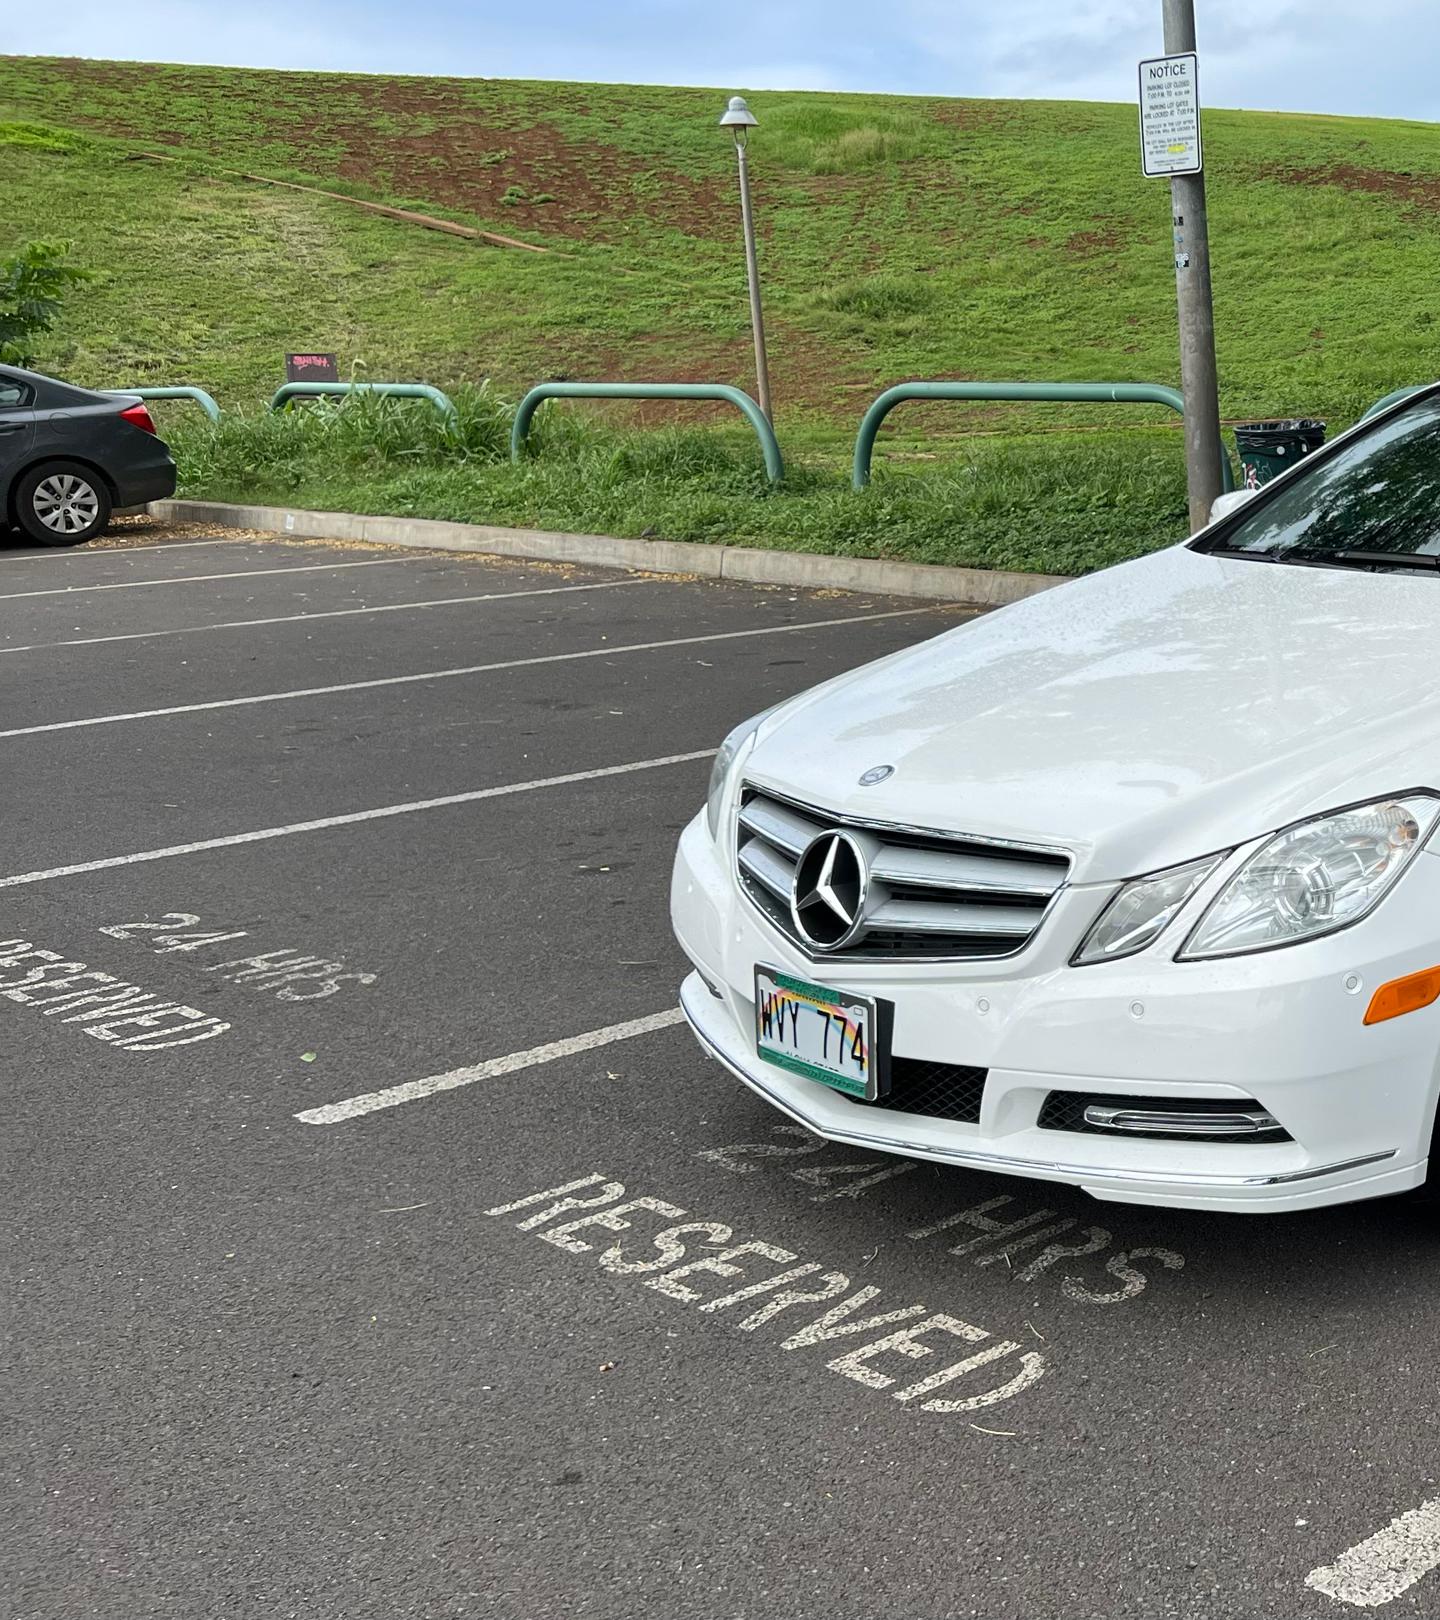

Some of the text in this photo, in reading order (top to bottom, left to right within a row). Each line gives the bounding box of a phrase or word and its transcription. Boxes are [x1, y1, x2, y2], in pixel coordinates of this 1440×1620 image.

[1149, 64, 1187, 79] NOTICE
[98, 912, 378, 1002] 24 HRS
[760, 988, 800, 1049] WVY
[816, 1009, 866, 1072] 774
[691, 1125, 1186, 1305] 24 HRS
[482, 1170, 1051, 1414] RESERVED
